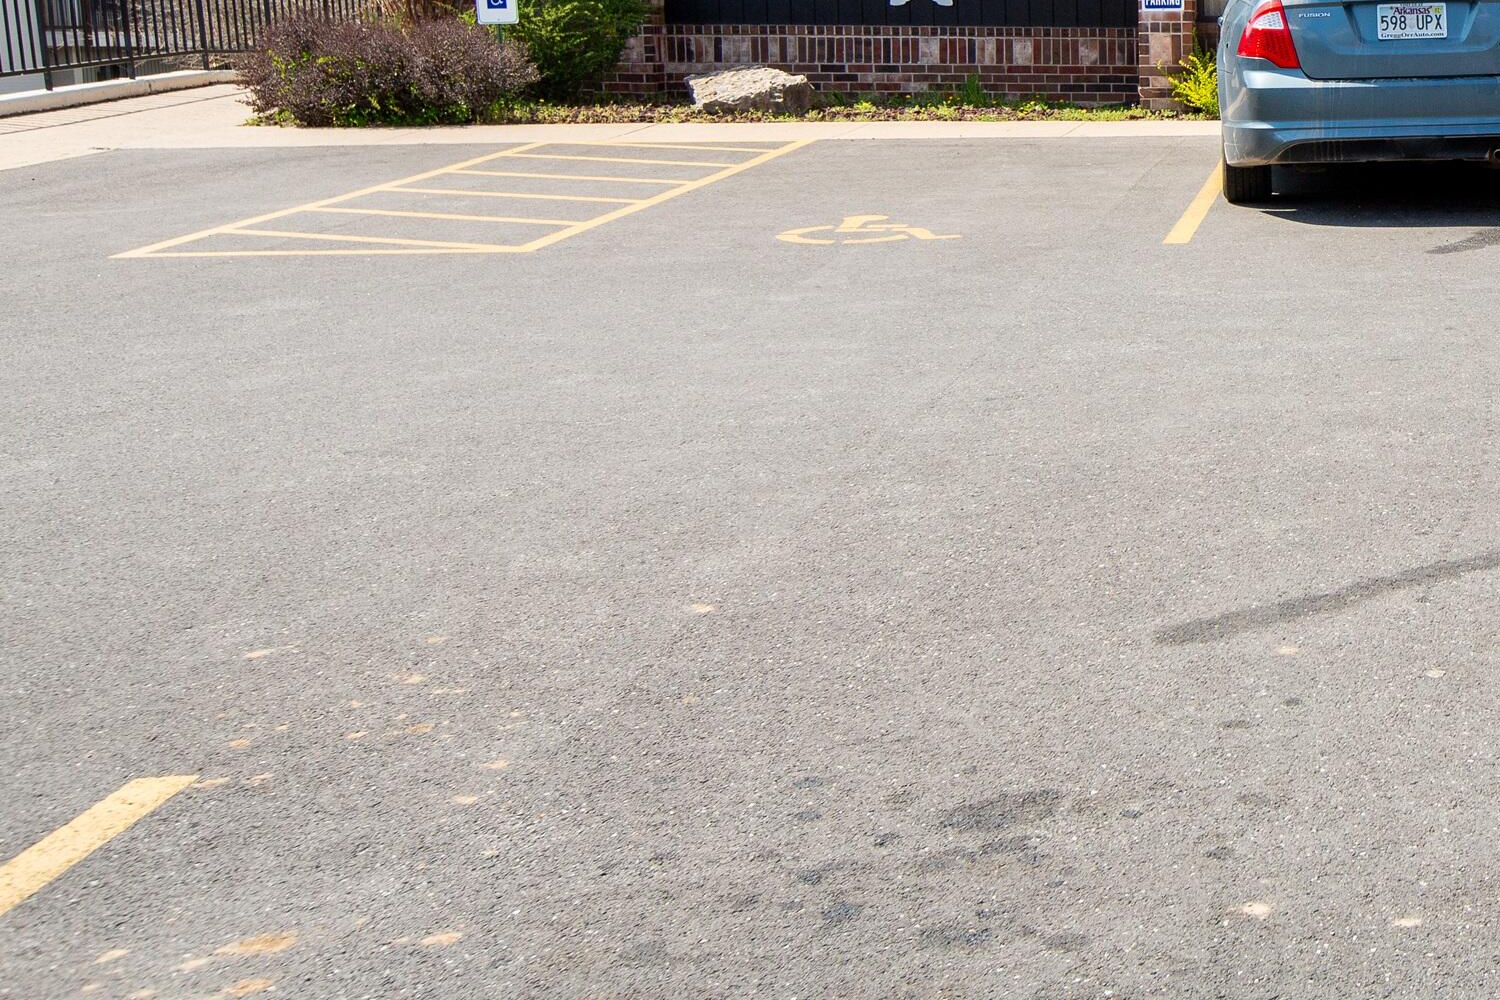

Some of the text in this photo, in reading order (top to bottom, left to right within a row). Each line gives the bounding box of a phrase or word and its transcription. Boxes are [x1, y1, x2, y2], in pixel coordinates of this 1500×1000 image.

[1393, 6, 1431, 15] Arkansas
[1380, 14, 1443, 31] 598 UPX
